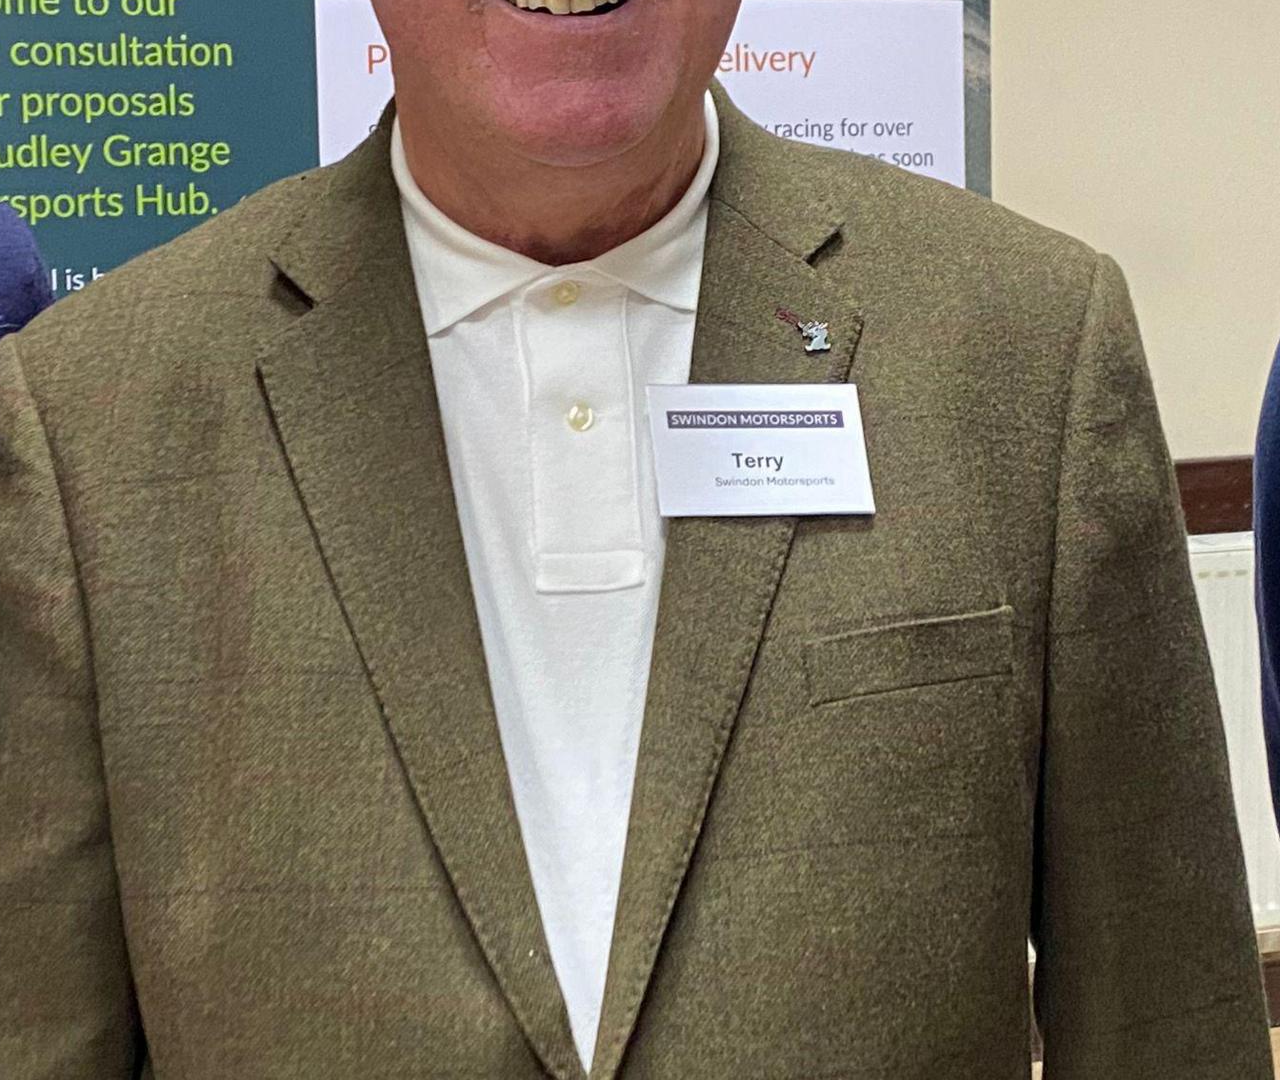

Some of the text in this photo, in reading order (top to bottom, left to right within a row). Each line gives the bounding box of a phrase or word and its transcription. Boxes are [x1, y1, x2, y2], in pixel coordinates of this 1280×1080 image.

[10, 33, 233, 67] consultation
[718, 43, 816, 78] elivery
[22, 84, 195, 124] proposals
[774, 118, 914, 141] racing for over
[103, 134, 231, 172] Grange
[892, 151, 934, 167] soon
[135, 183, 218, 216] Hub.
[65, 268, 85, 291] is
[671, 413, 838, 426] SWINDON MOTORSPORTS
[732, 452, 784, 471] Terry
[715, 476, 835, 487] Swindon Motorsports
